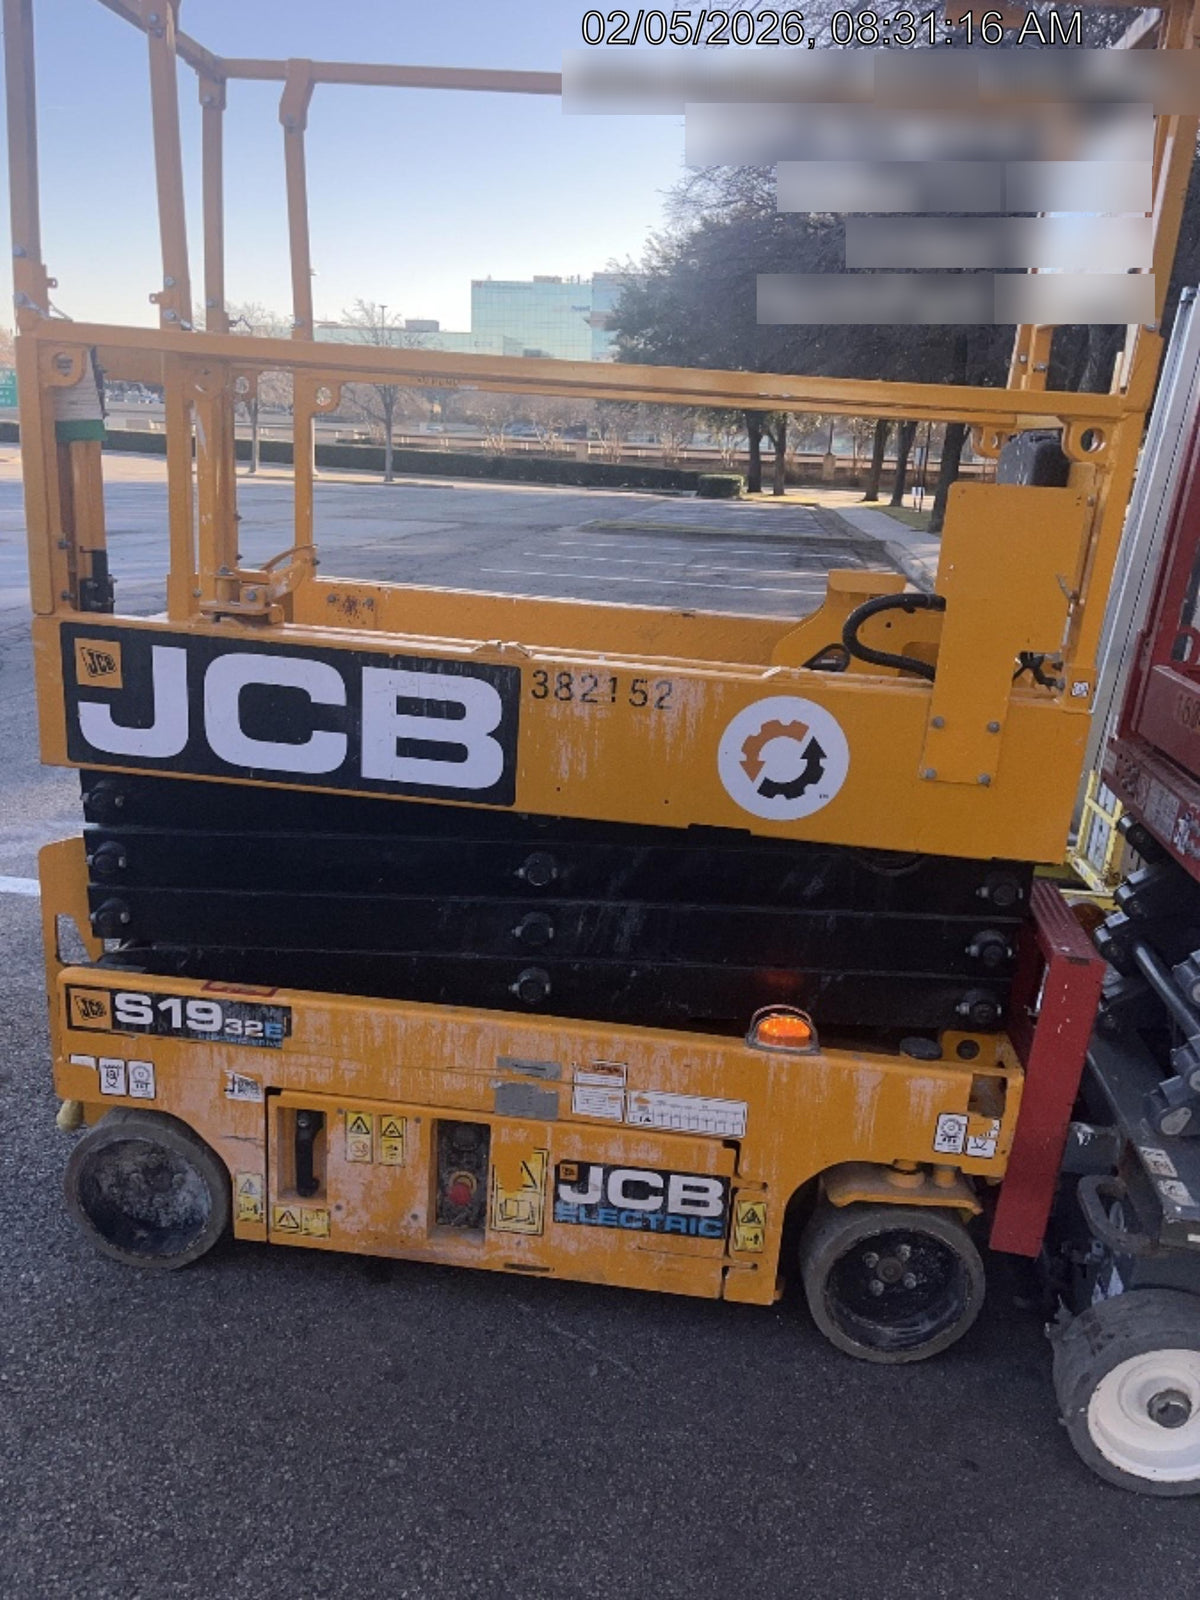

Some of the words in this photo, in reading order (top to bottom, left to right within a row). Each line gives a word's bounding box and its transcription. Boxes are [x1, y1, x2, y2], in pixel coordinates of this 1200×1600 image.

[81, 647, 117, 677] JCB
[531, 670, 674, 710] 382152
[77, 644, 505, 790] JCB
[558, 1165, 724, 1217] JCB
[555, 1200, 723, 1237] ELECTRIC
